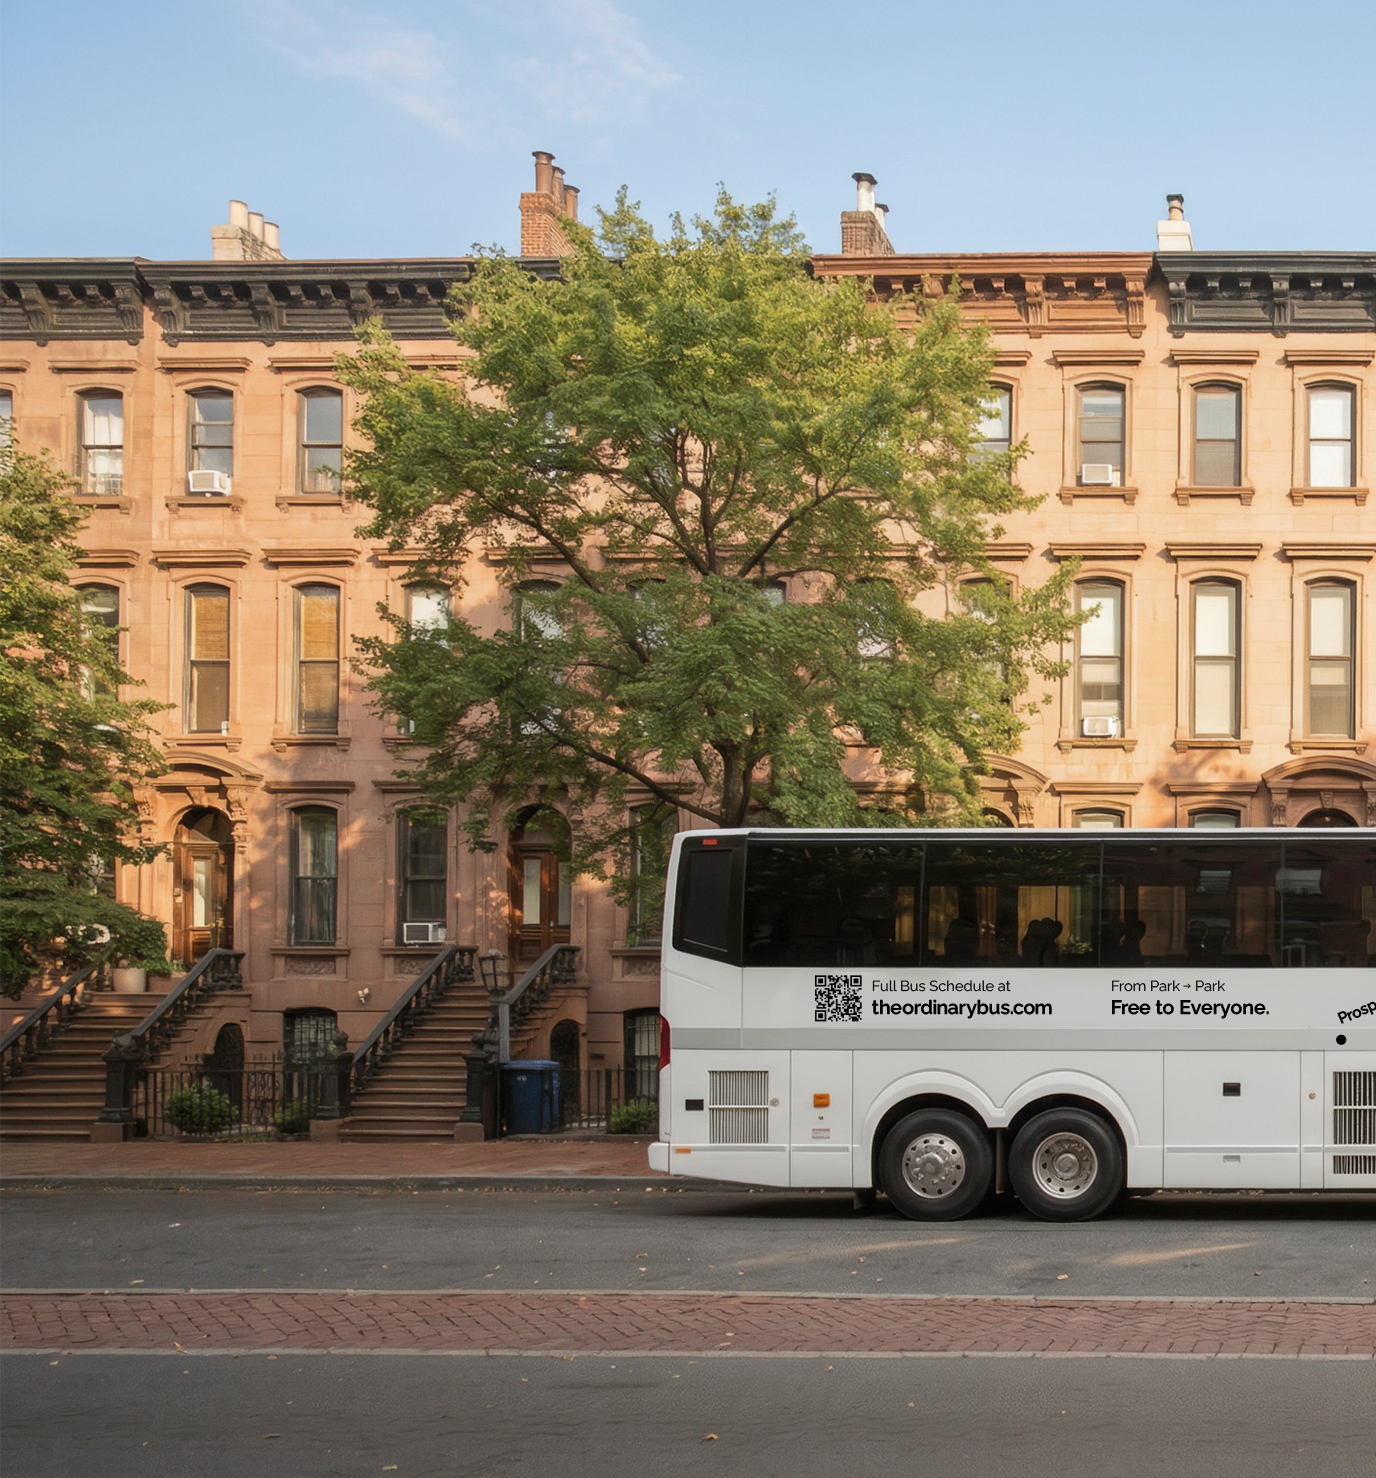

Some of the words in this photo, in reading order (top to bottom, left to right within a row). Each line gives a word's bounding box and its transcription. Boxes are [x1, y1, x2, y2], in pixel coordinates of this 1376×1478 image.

[873, 979, 897, 992] Full
[901, 979, 925, 992] Bus
[930, 979, 995, 992] Schedule
[997, 980, 1011, 992] at
[1112, 979, 1146, 992] From
[1151, 979, 1180, 992] Park
[1196, 979, 1225, 992] Park
[872, 999, 1053, 1019] theordinarybus.com
[1112, 999, 1151, 1015] Free
[1156, 1000, 1174, 1015] to
[1179, 999, 1270, 1019] Everyone.
